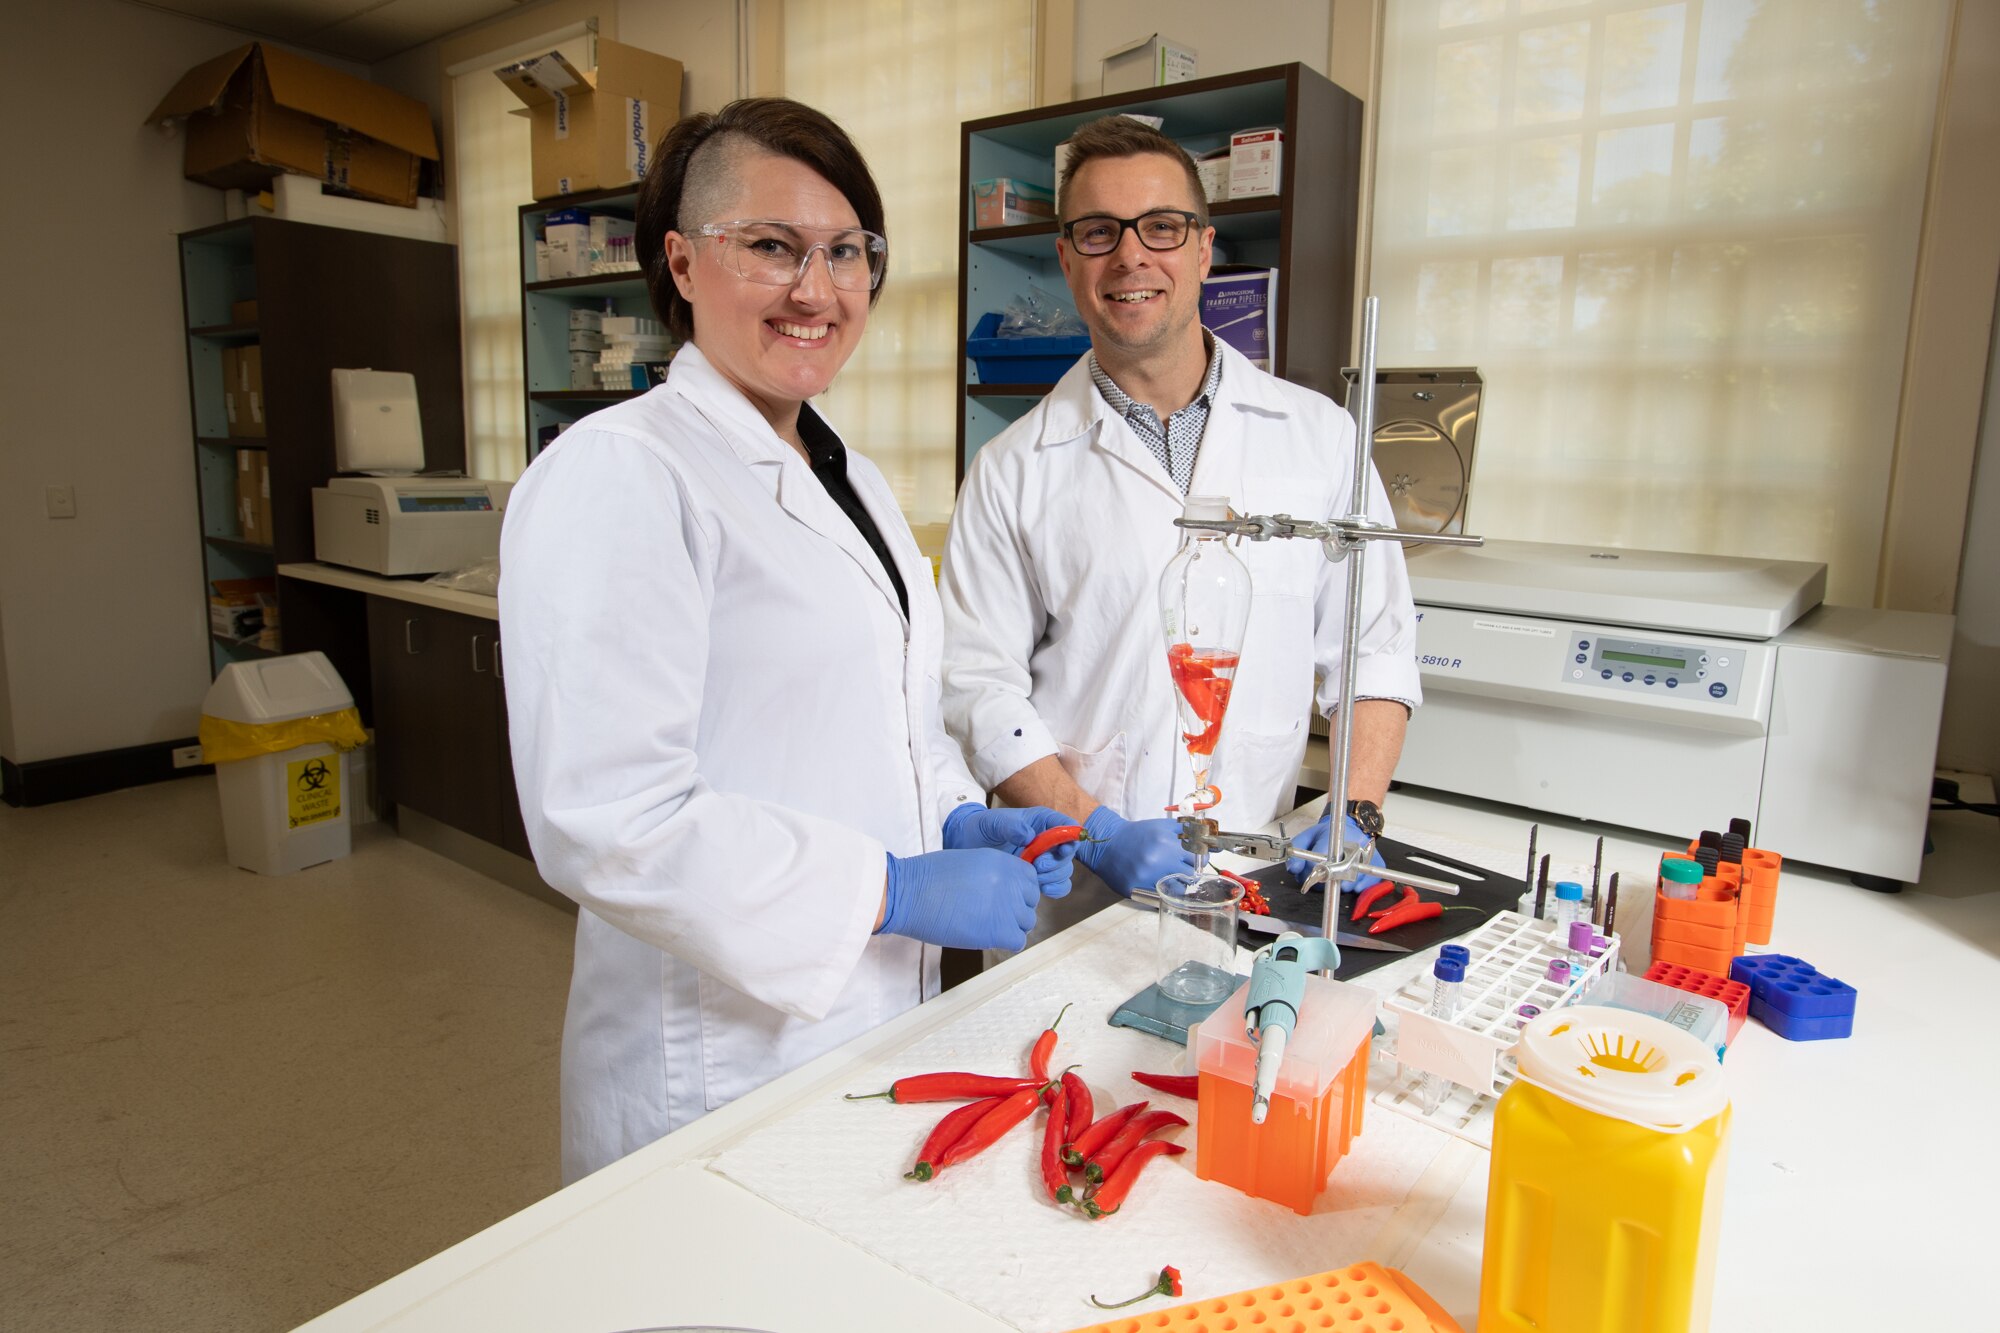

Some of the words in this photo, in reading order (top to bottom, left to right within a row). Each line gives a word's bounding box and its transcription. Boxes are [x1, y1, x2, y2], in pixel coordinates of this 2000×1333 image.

[1206, 298, 1237, 307] TRANSFER
[1238, 293, 1267, 304] PIPETTES
[1421, 655, 1450, 667] 5810
[1451, 659, 1462, 669] R
[295, 789, 333, 803] CLINICAL
[302, 799, 329, 811] WASTE
